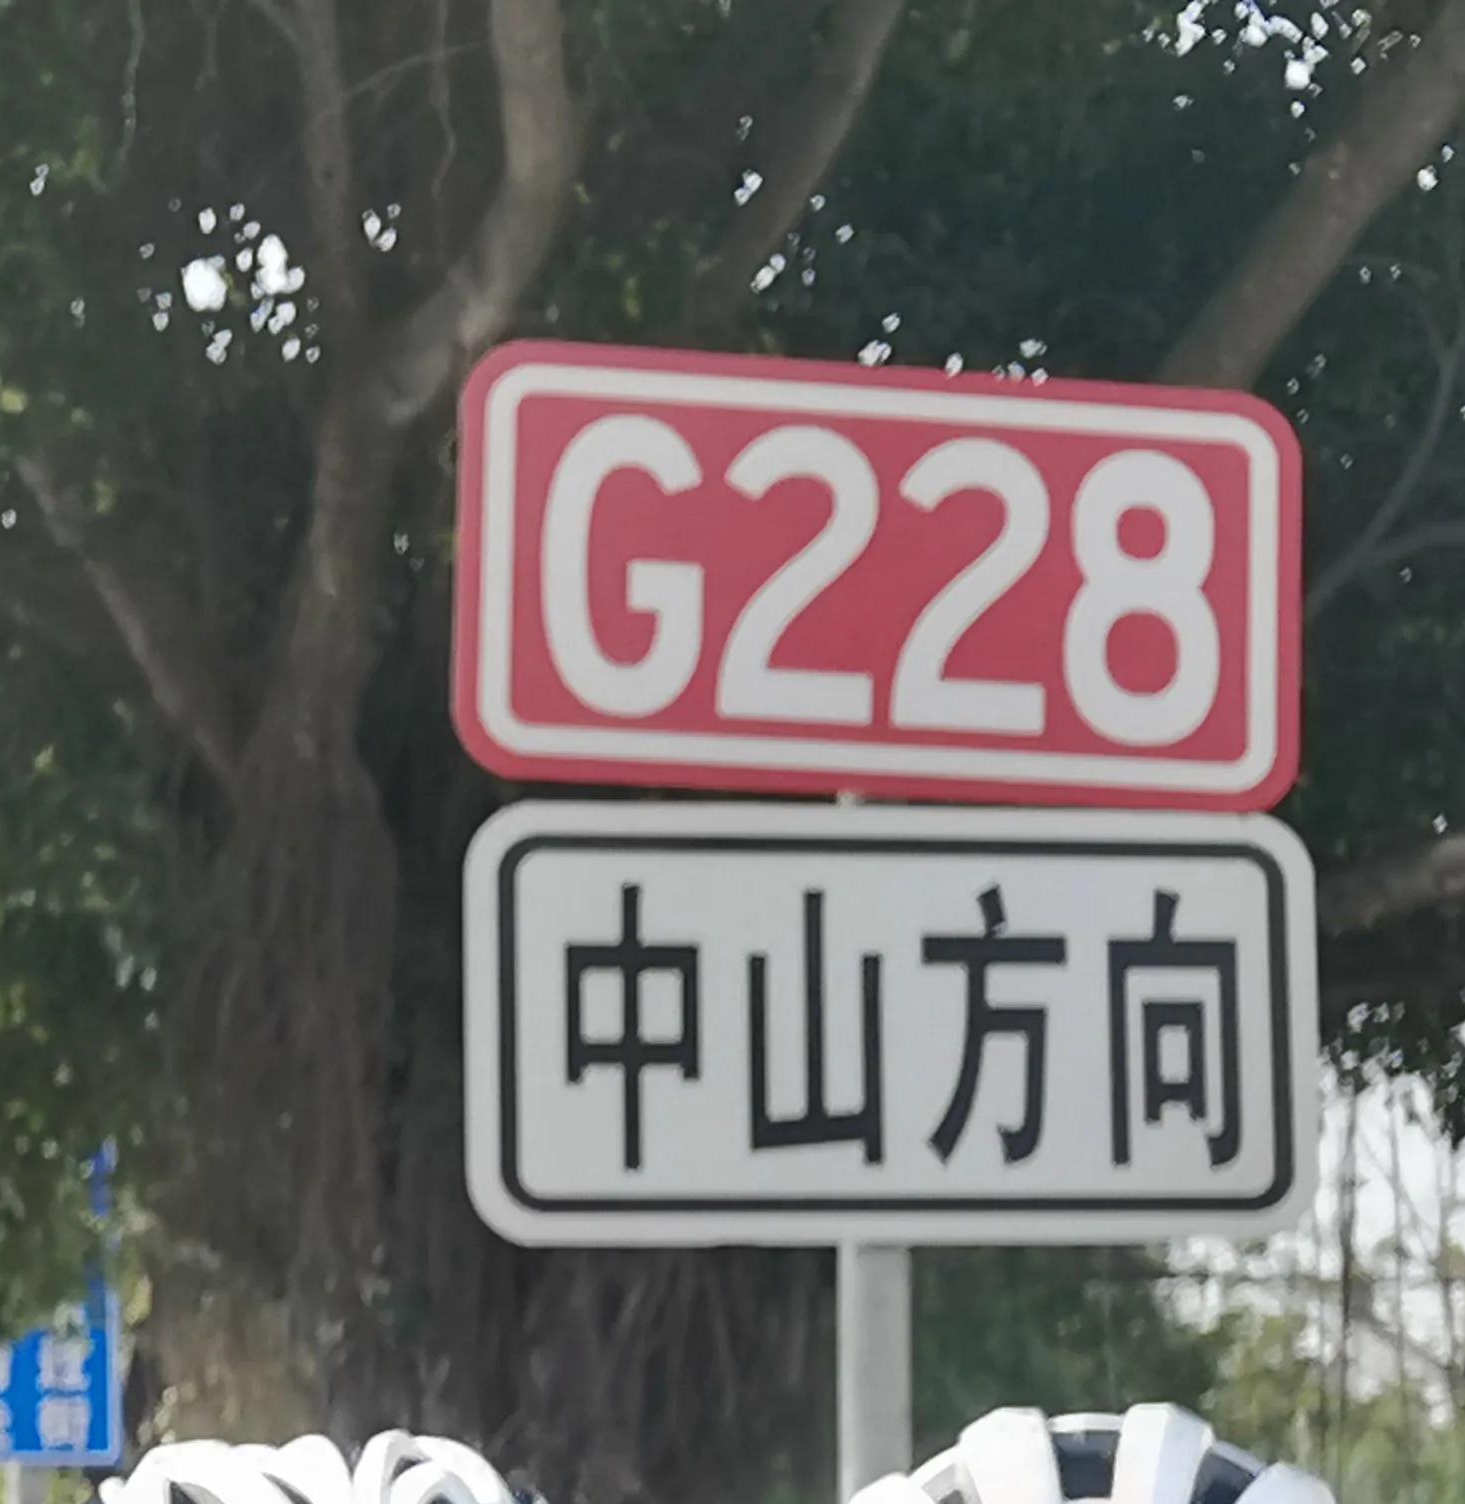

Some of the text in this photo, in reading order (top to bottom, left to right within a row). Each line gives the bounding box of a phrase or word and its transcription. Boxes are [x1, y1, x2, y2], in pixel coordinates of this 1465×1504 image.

[541, 413, 1221, 746] G228
[565, 882, 1243, 1171] 中山方向
